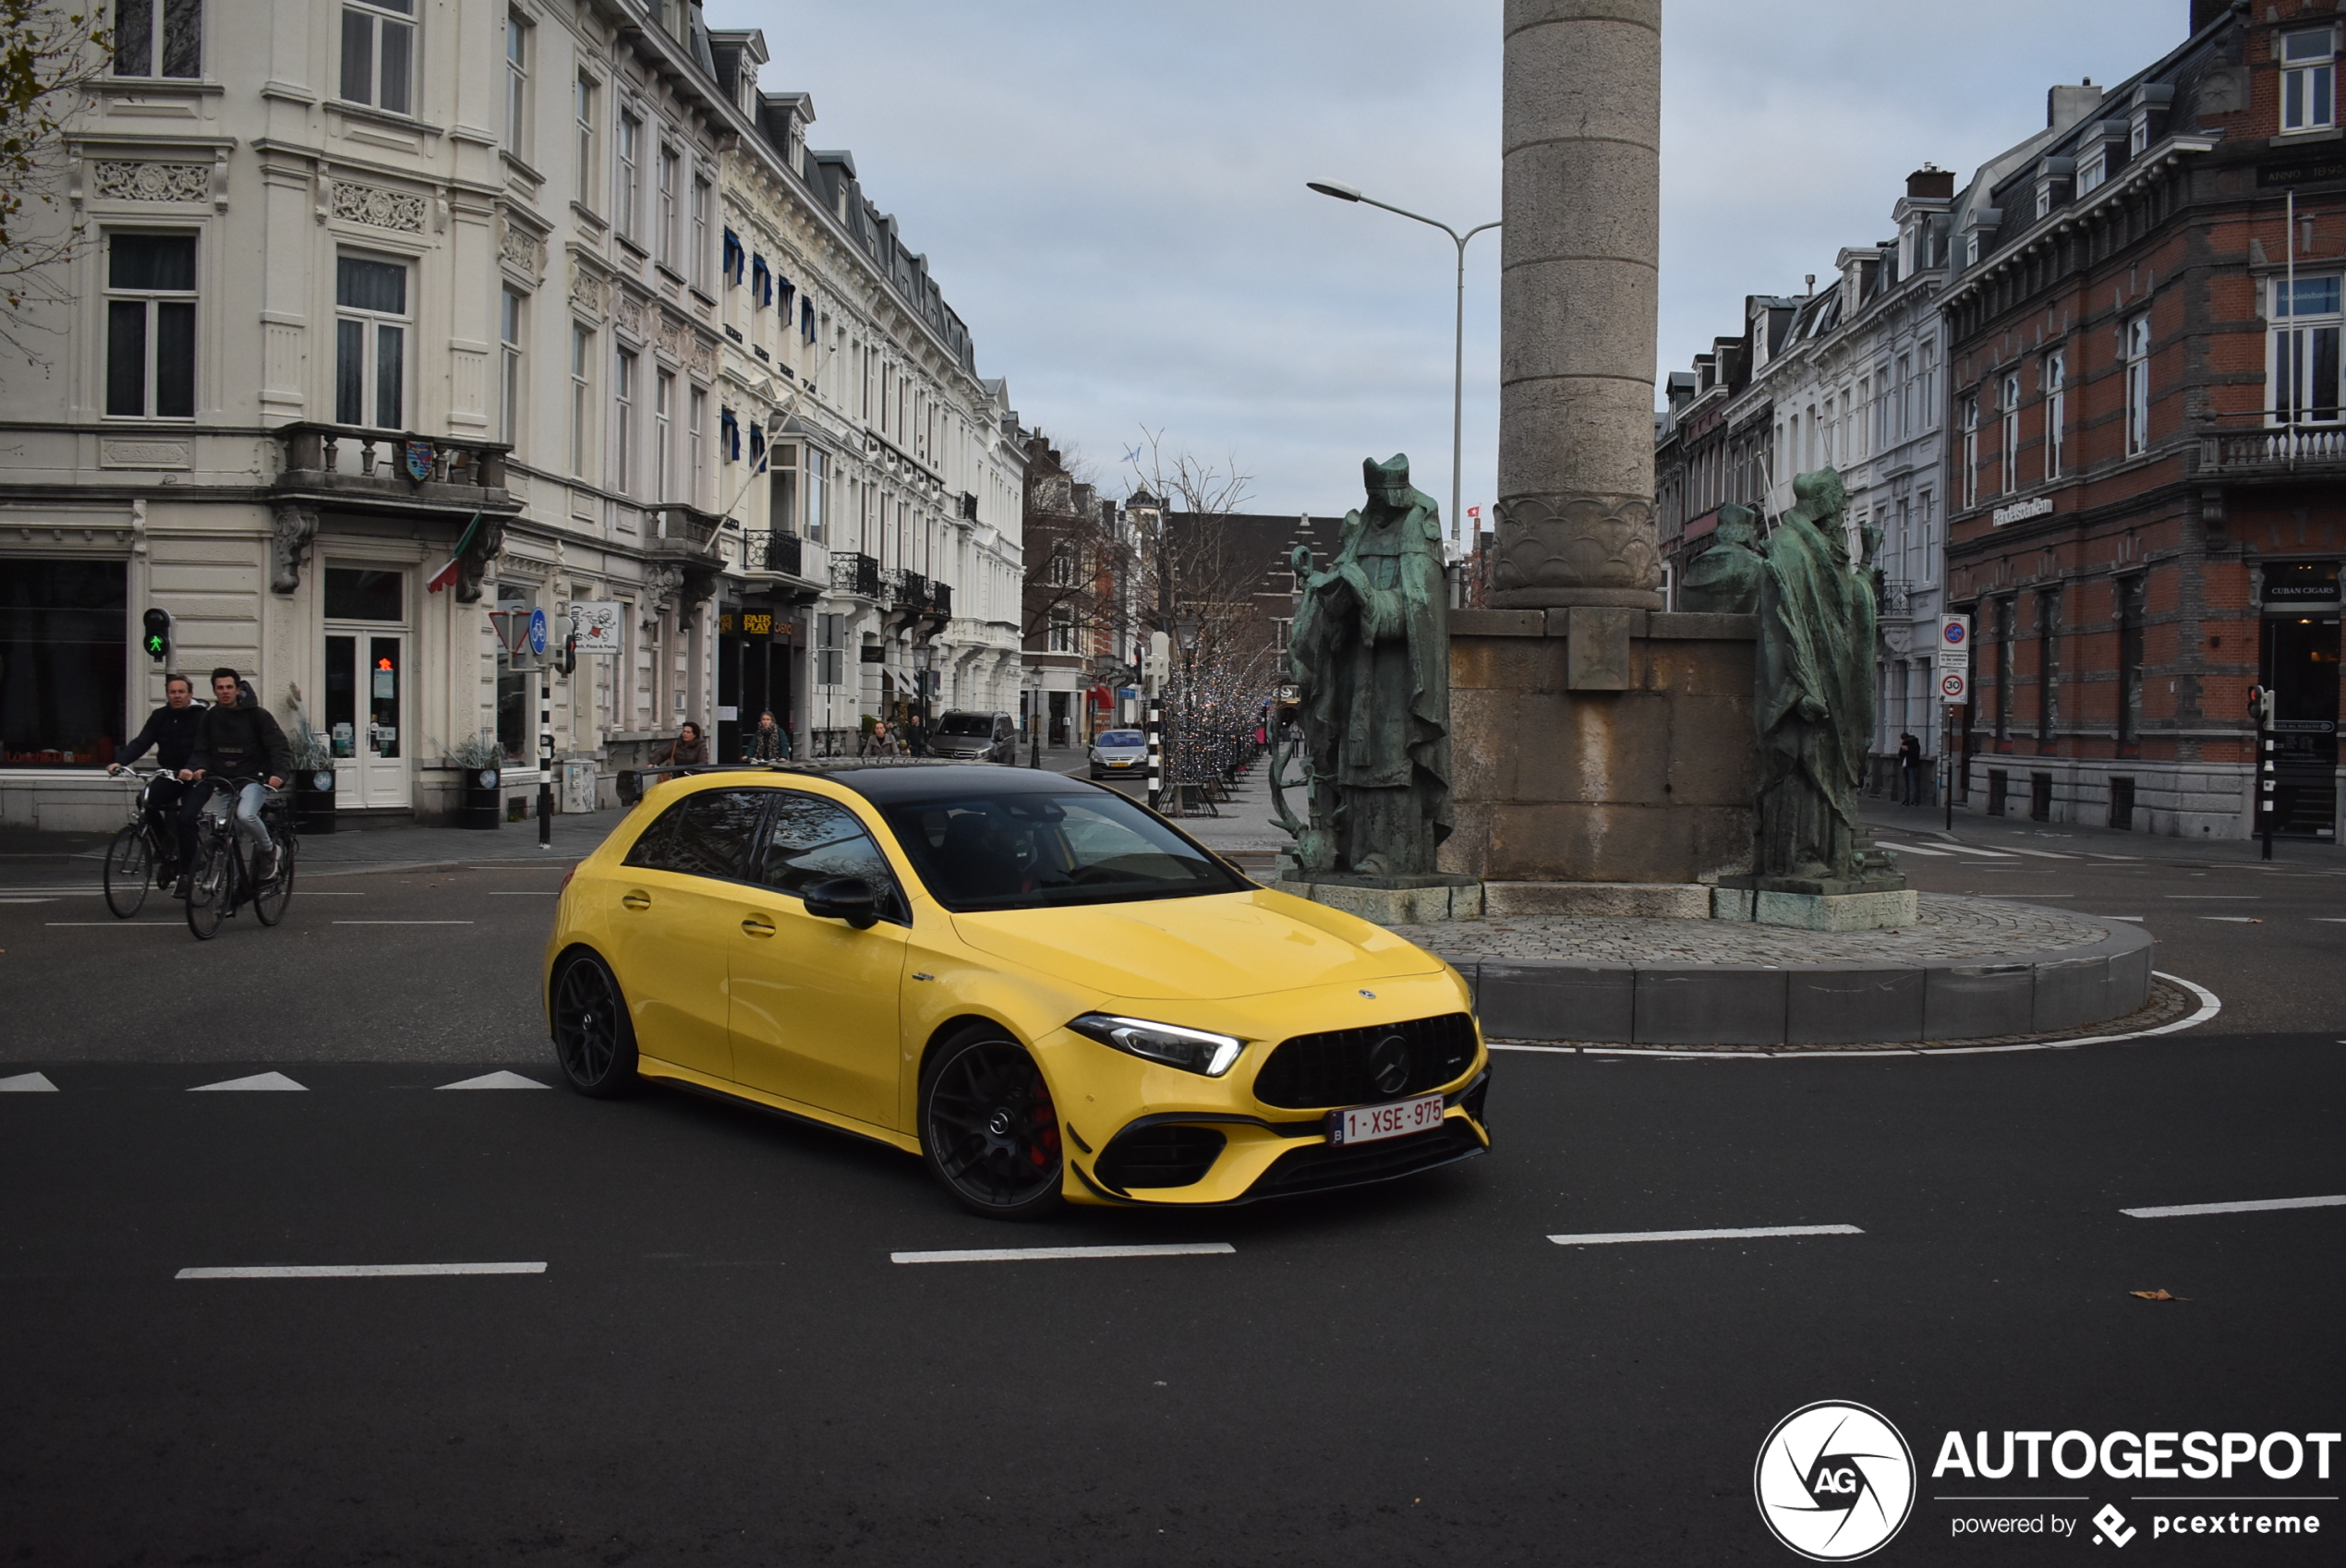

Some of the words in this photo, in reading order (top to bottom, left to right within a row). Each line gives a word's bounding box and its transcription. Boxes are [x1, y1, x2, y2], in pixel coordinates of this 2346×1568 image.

[2267, 170, 2301, 182] ANNO
[1993, 497, 2052, 527] Handelsbanken
[2271, 586, 2301, 595] CUBAN
[744, 614, 772, 623] FAIR
[744, 622, 771, 632] PLAY
[1946, 681, 1960, 690] 30
[1348, 1099, 1442, 1138] 1-XSE-975
[1334, 1129, 1343, 1141] B
